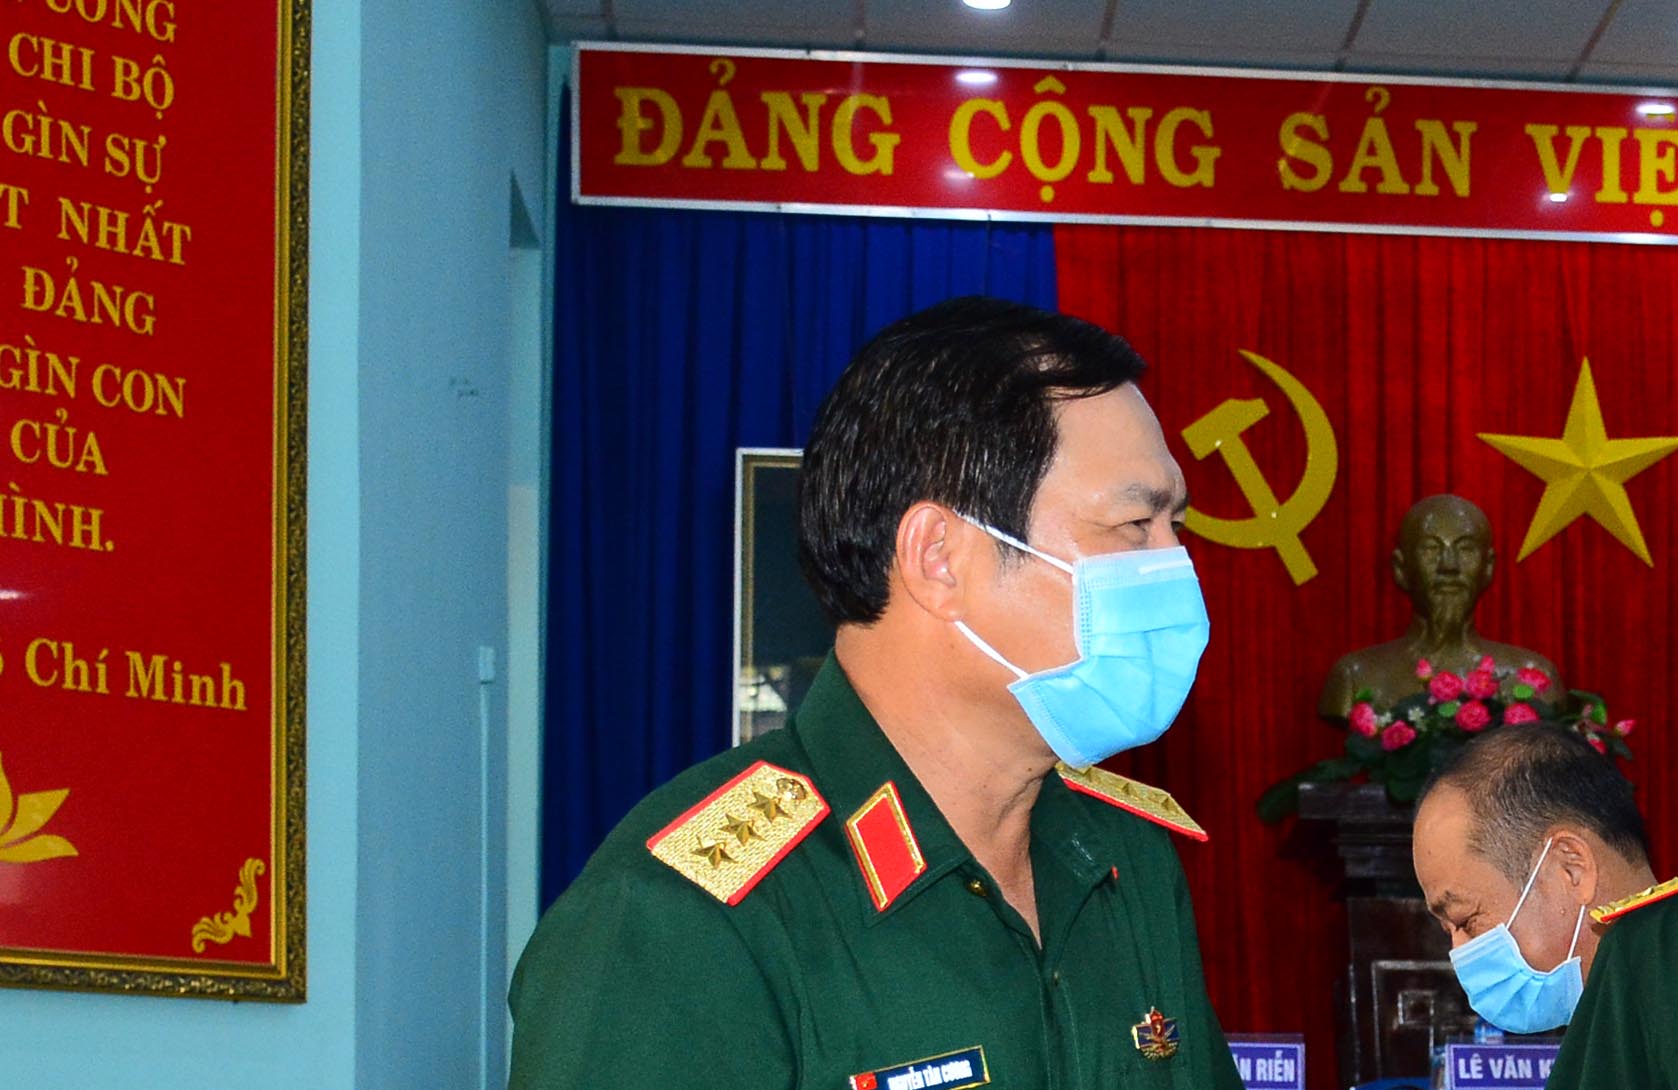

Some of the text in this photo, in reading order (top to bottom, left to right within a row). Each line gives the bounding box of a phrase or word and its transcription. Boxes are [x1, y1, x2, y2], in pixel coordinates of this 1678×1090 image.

[8, 32, 175, 120] CHI BỘ
[2, 99, 167, 194] GÌN SỰ
[614, 58, 900, 176] ĐẢNG
[949, 74, 1221, 203] CỘNG
[1277, 86, 1478, 198] SẢN
[57, 198, 192, 266] NHẤT
[21, 255, 157, 336] ĐẢNG
[0, 334, 187, 419] GÌN CON
[10, 407, 109, 476] CỦA
[25, 638, 110, 694] Chí
[125, 650, 247, 711] Minh
[1458, 1053, 1484, 1080] LÊ
[1489, 1055, 1532, 1080] VĂN
